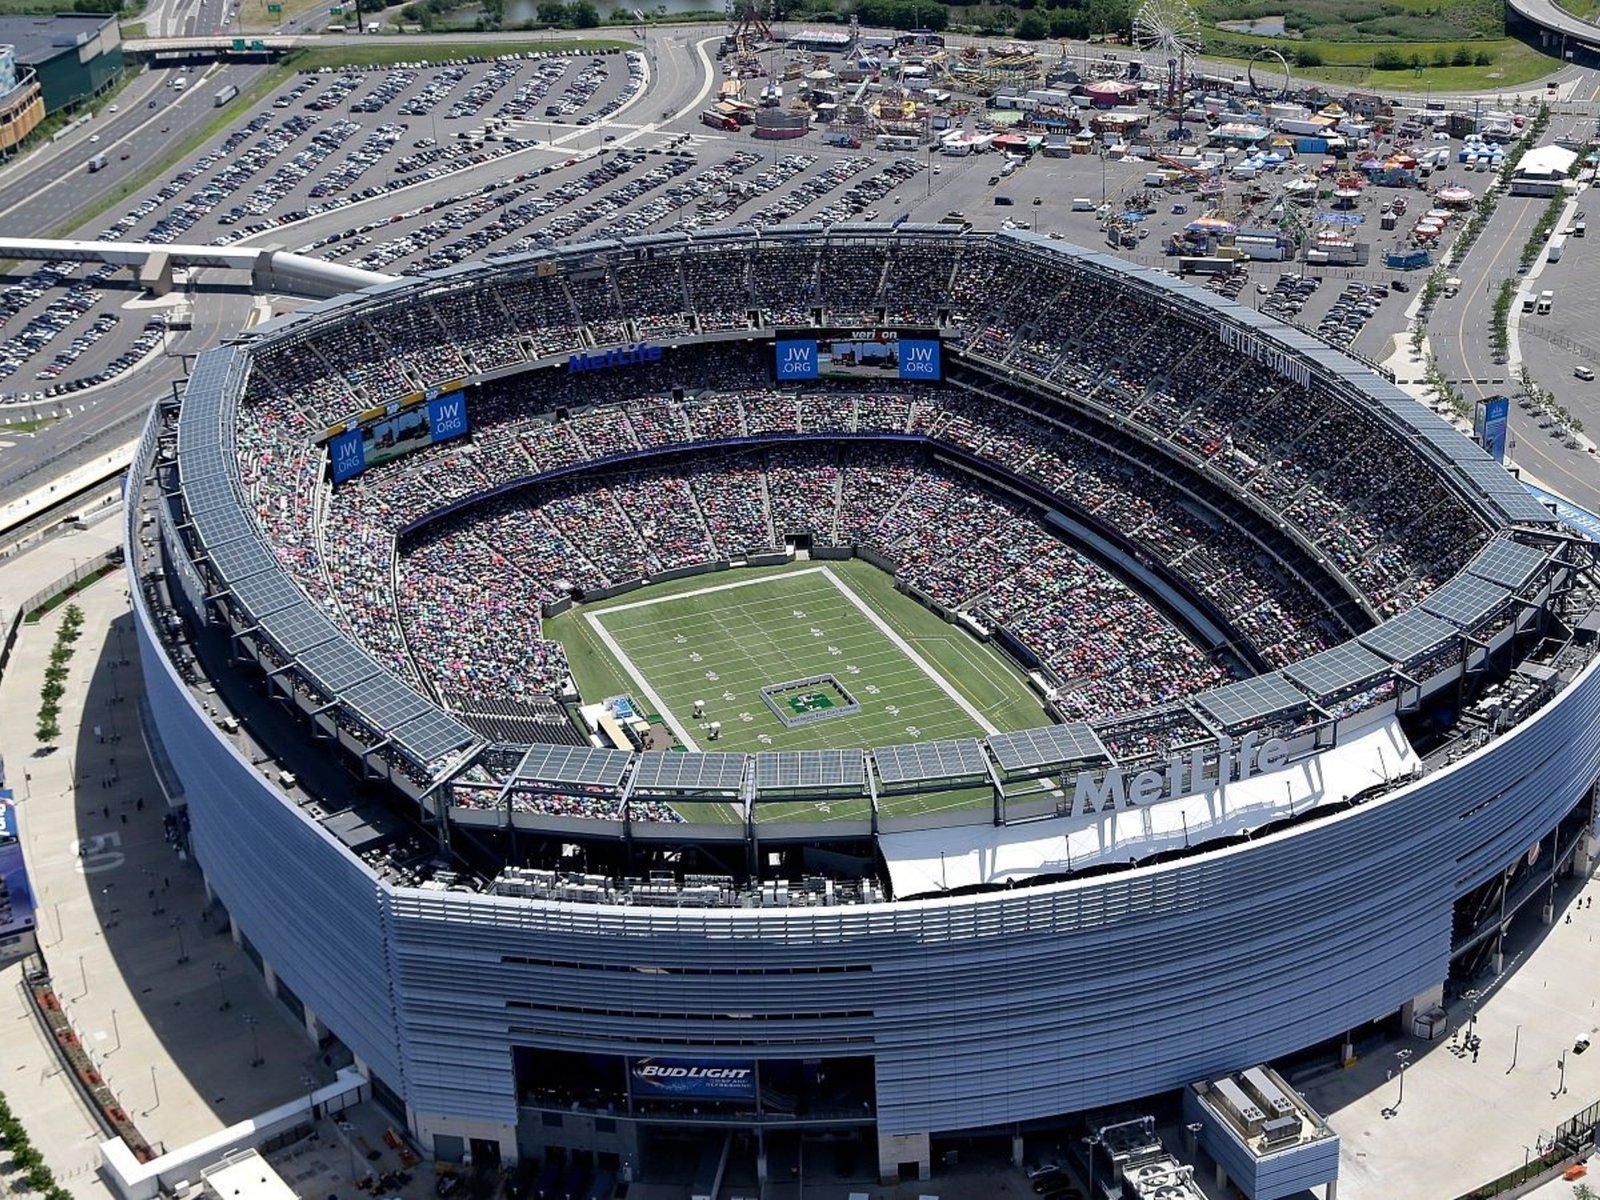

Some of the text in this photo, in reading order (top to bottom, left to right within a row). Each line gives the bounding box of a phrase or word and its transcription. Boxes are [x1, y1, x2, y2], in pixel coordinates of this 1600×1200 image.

[568, 341, 662, 374] MetLife
[784, 347, 810, 361] JW
[906, 347, 933, 361] JW
[1220, 323, 1311, 391] METLIFE STADIUM
[436, 401, 459, 422] JW
[338, 439, 358, 461] JW
[1071, 731, 1289, 818] MetLife
[642, 1066, 750, 1078] BUD LIGHT
